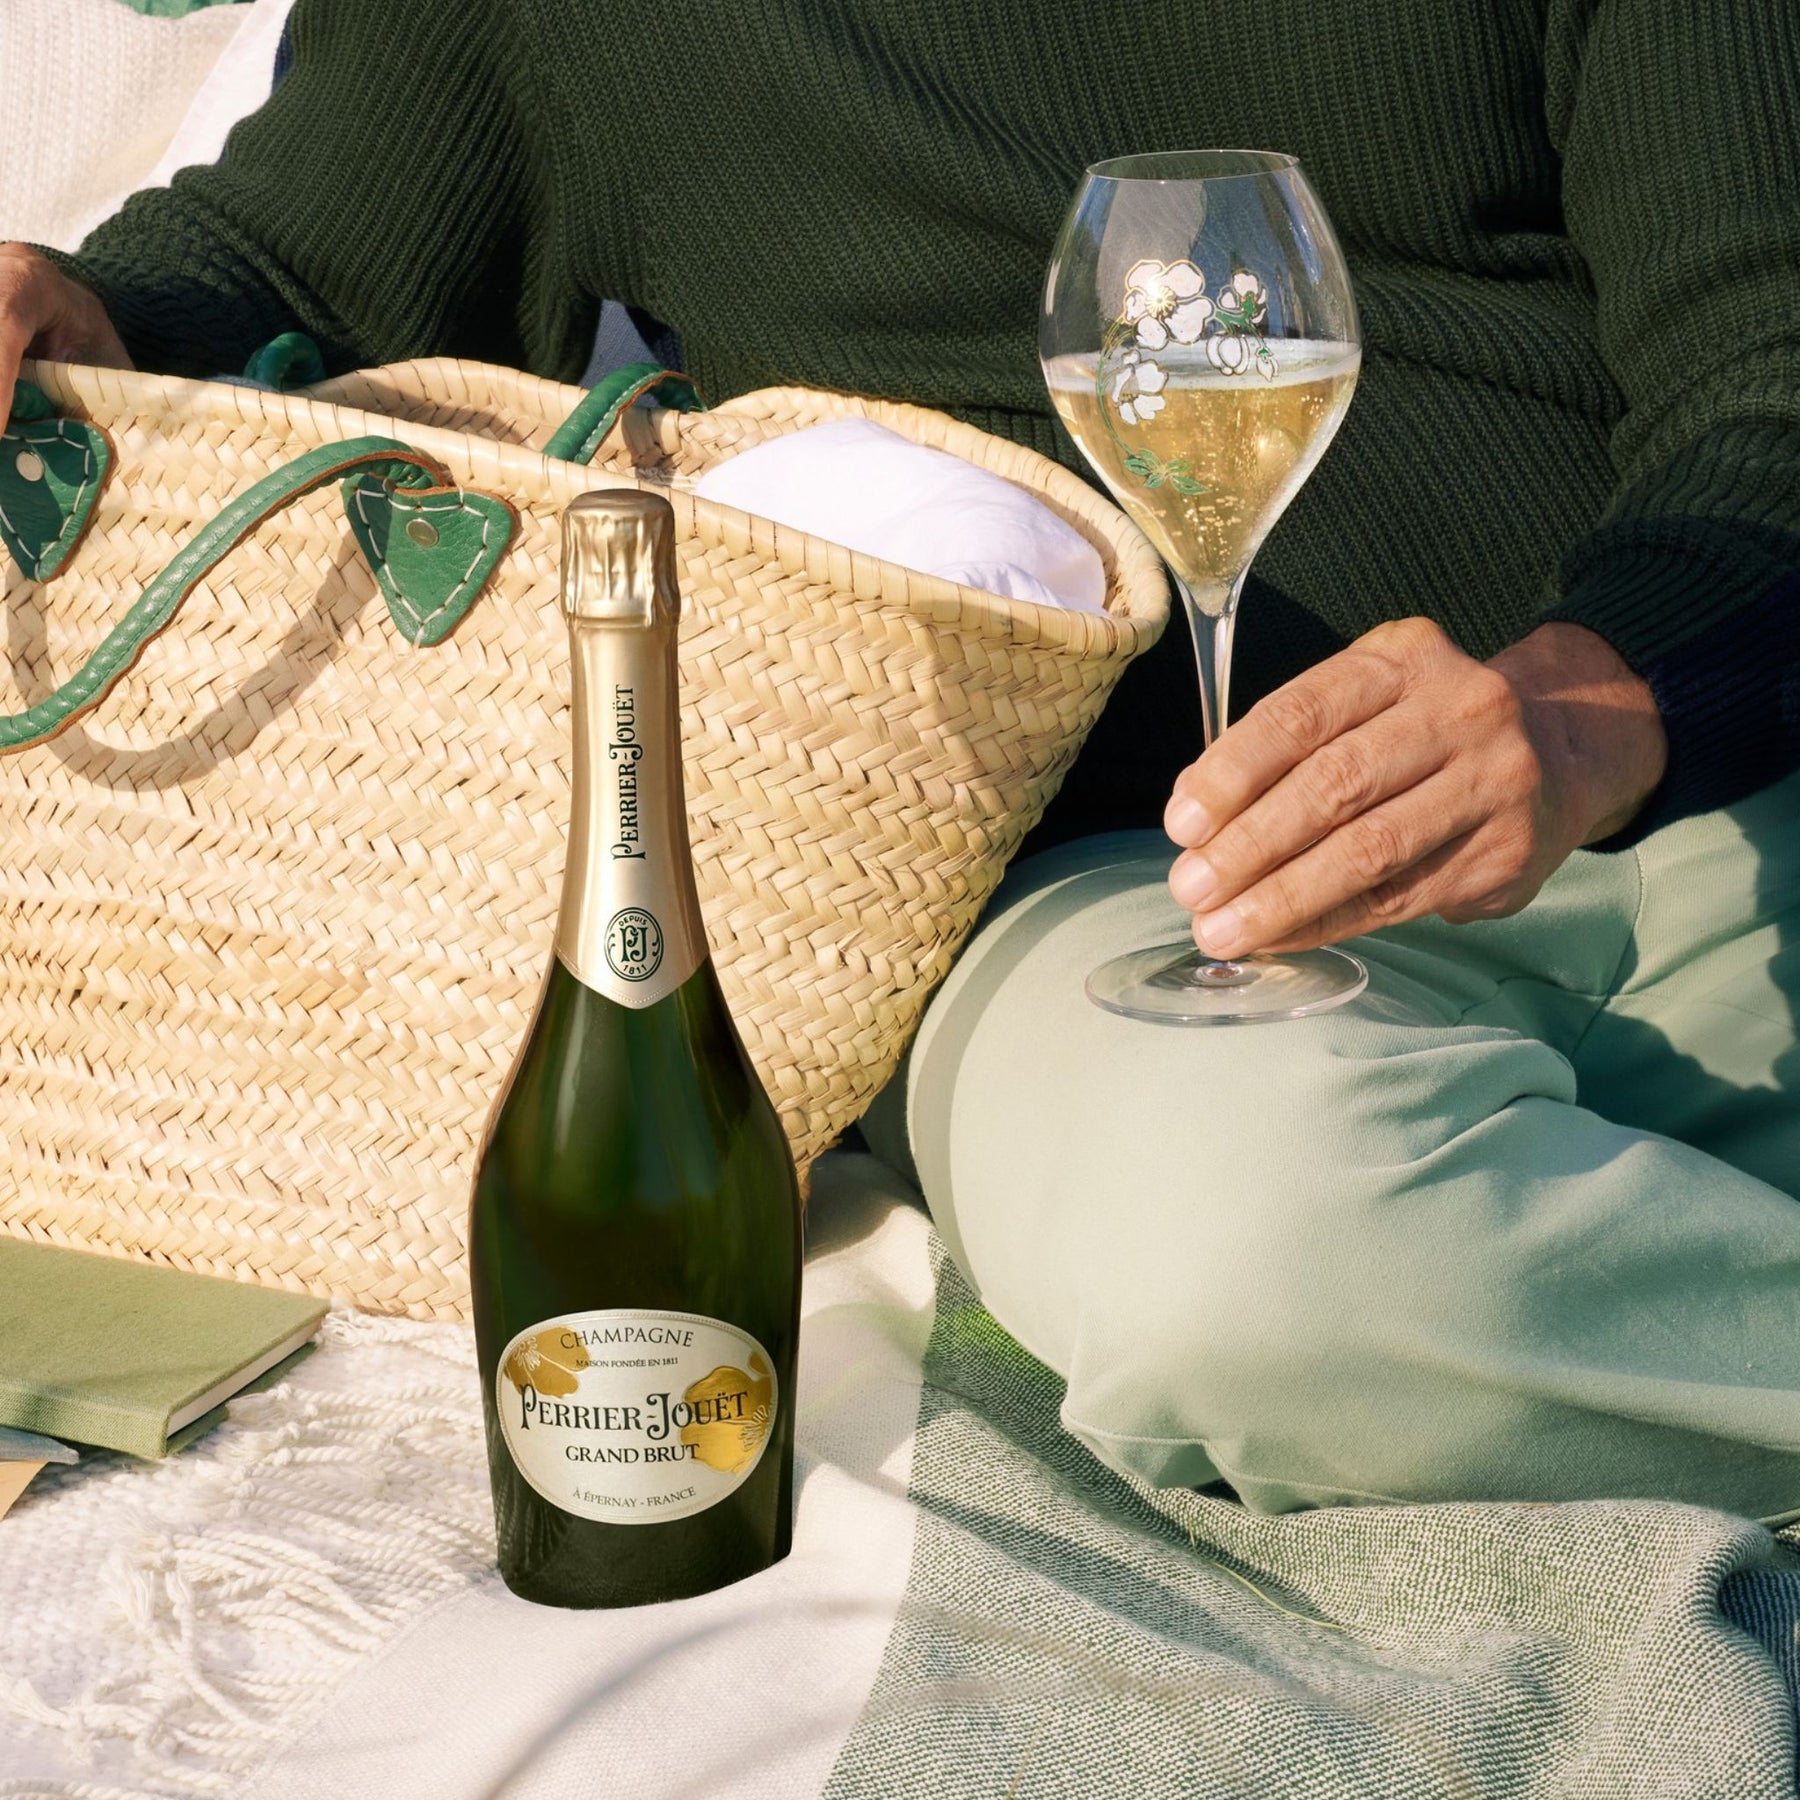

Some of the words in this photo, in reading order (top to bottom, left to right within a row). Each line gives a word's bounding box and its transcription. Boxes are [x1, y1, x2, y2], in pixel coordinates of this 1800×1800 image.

[618, 915, 648, 927] DEPUIS
[623, 964, 648, 975] 1811
[560, 1327, 694, 1350] CHAMPAGNE
[575, 1359, 609, 1368] MAISON
[610, 1356, 646, 1368] FONDÉE
[648, 1358, 661, 1367] EN
[662, 1357, 679, 1366] 1811
[565, 1445, 639, 1464] GRAND
[644, 1443, 700, 1463] BRUT
[572, 1486, 582, 1500] À
[583, 1489, 637, 1508] ÉPERNAY
[646, 1486, 697, 1507] FRANCE
